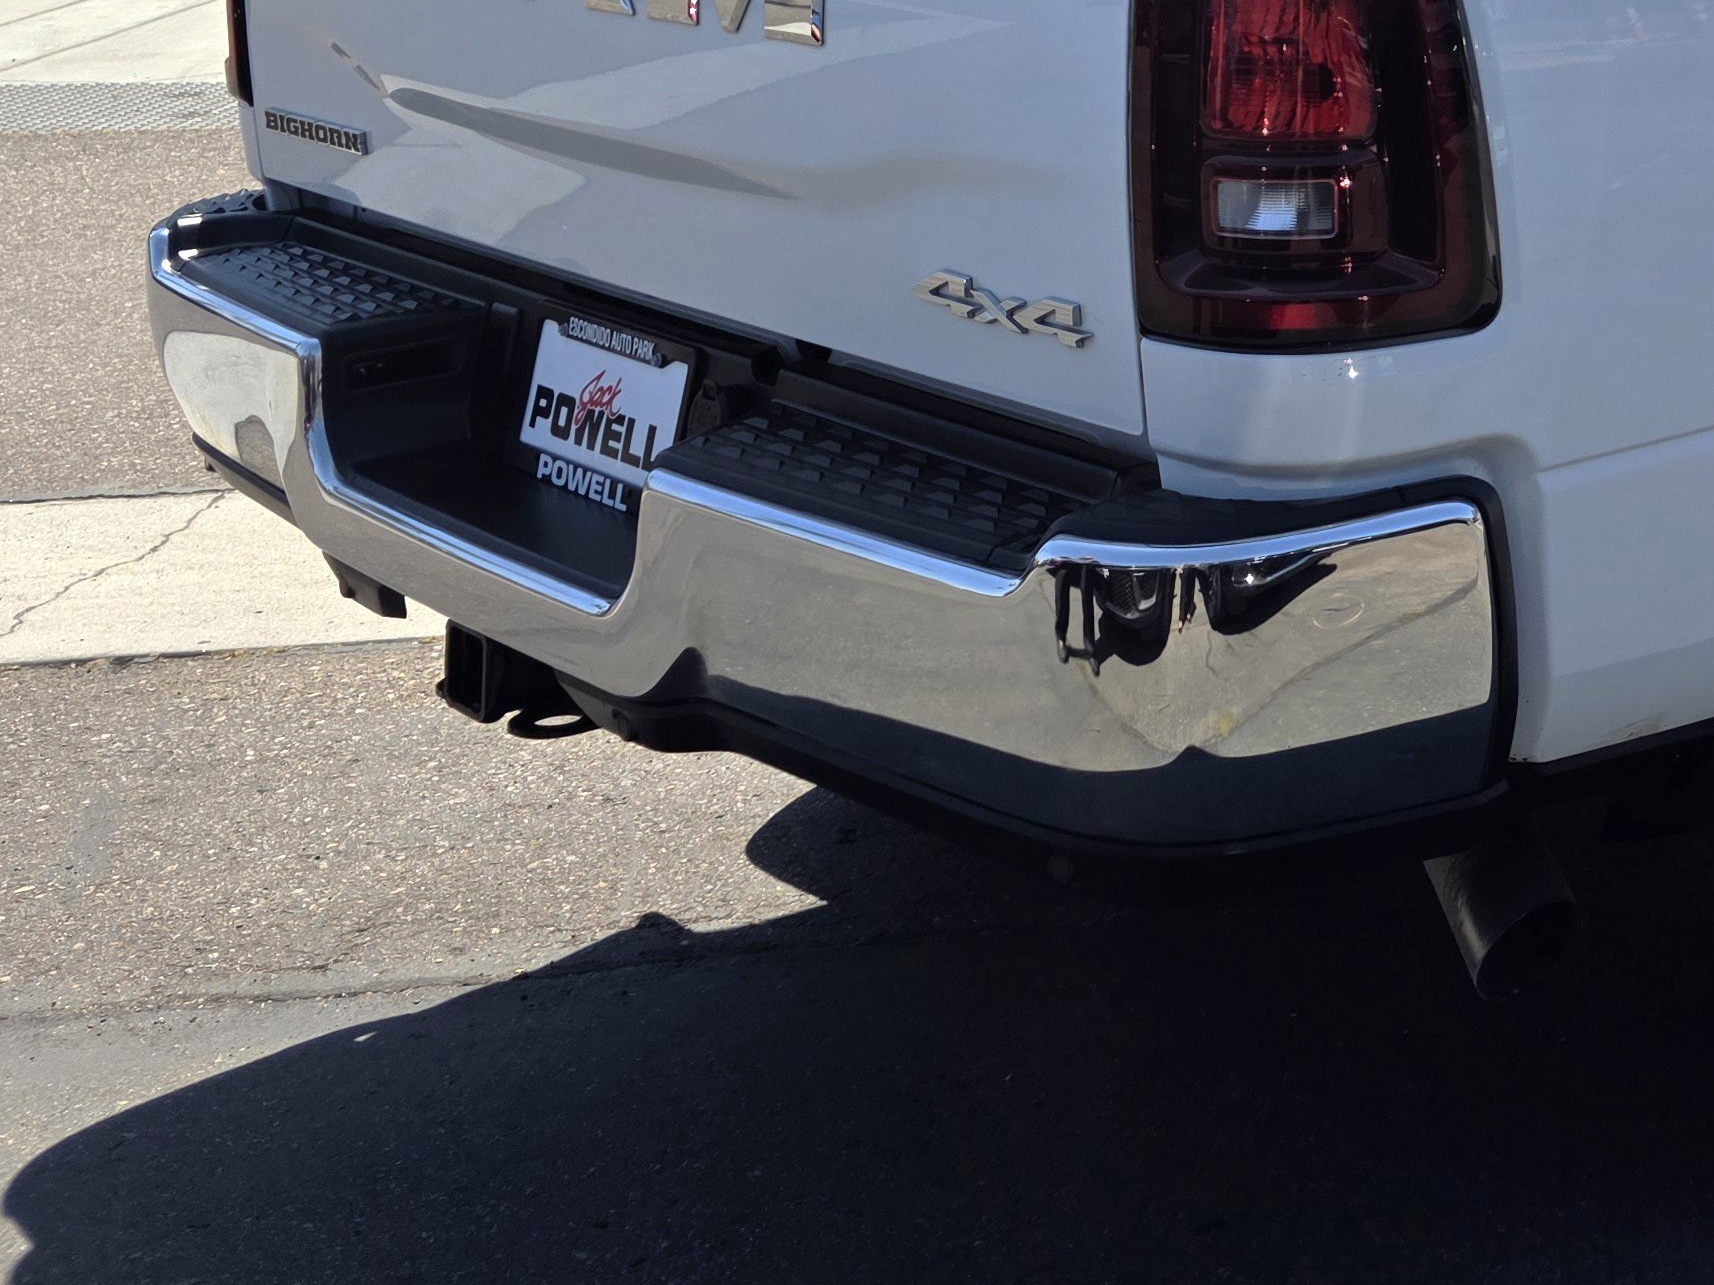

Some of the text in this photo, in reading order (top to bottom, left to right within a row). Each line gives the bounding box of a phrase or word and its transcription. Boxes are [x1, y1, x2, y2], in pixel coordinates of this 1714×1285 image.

[264, 110, 362, 154] BIGHORN
[911, 268, 1097, 349] 4x4
[568, 316, 656, 361] ESCONDIDO AUTO PARK
[573, 369, 623, 427] Jack
[528, 383, 658, 475] POWELL
[536, 452, 628, 512] POWELL
